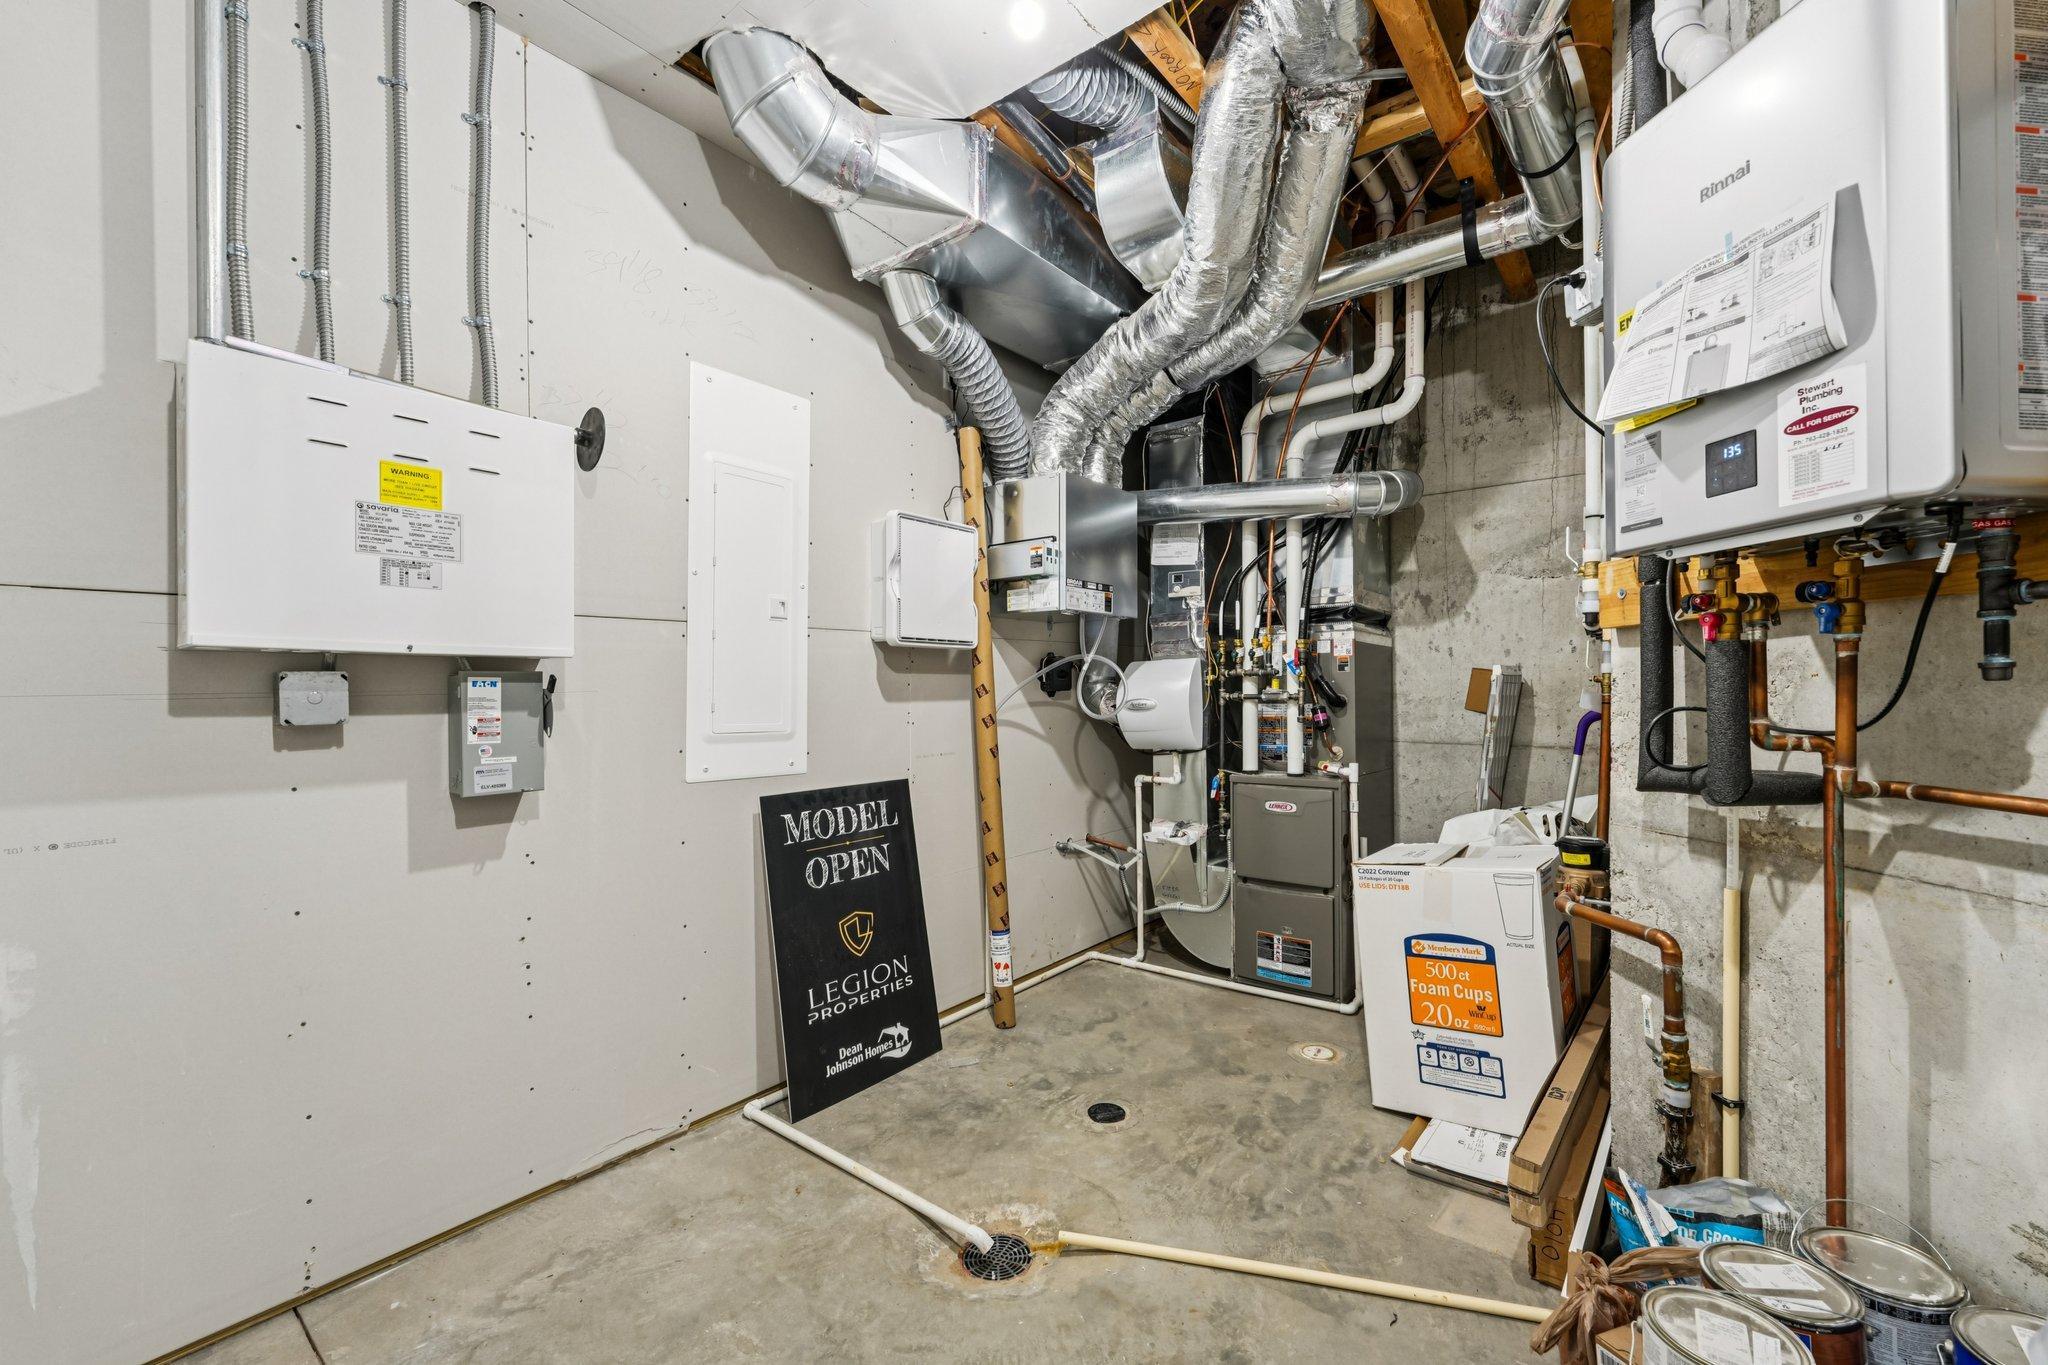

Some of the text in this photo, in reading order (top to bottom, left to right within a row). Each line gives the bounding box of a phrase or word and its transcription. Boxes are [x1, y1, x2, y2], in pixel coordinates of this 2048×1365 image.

[1700, 159, 1751, 203] Rinnai
[1797, 378, 1835, 397] Stewart
[1799, 386, 1843, 405] Plumbing
[1802, 405, 1820, 414] Inc.
[1786, 407, 1856, 434] CALL FOR SERVICE
[1723, 443, 1742, 459] 135
[390, 467, 432, 480] WARNING:
[366, 503, 399, 514] savaria
[780, 799, 899, 845] MODEL
[805, 843, 890, 889] OPEN
[1357, 867, 1411, 876] C2022 Consumer
[1427, 944, 1482, 955] Member's Mark
[1425, 961, 1470, 981] 500 ct
[808, 955, 908, 1010] LEGION
[1410, 978, 1493, 1004] Foam Cups
[807, 975, 914, 1026] PROPERTIES
[1421, 1001, 1453, 1027] 20
[1454, 1018, 1470, 1029] oz
[1468, 1009, 1497, 1022] WinCup
[825, 1039, 894, 1078] Johnson Homes
[838, 1042, 863, 1060] Dean
